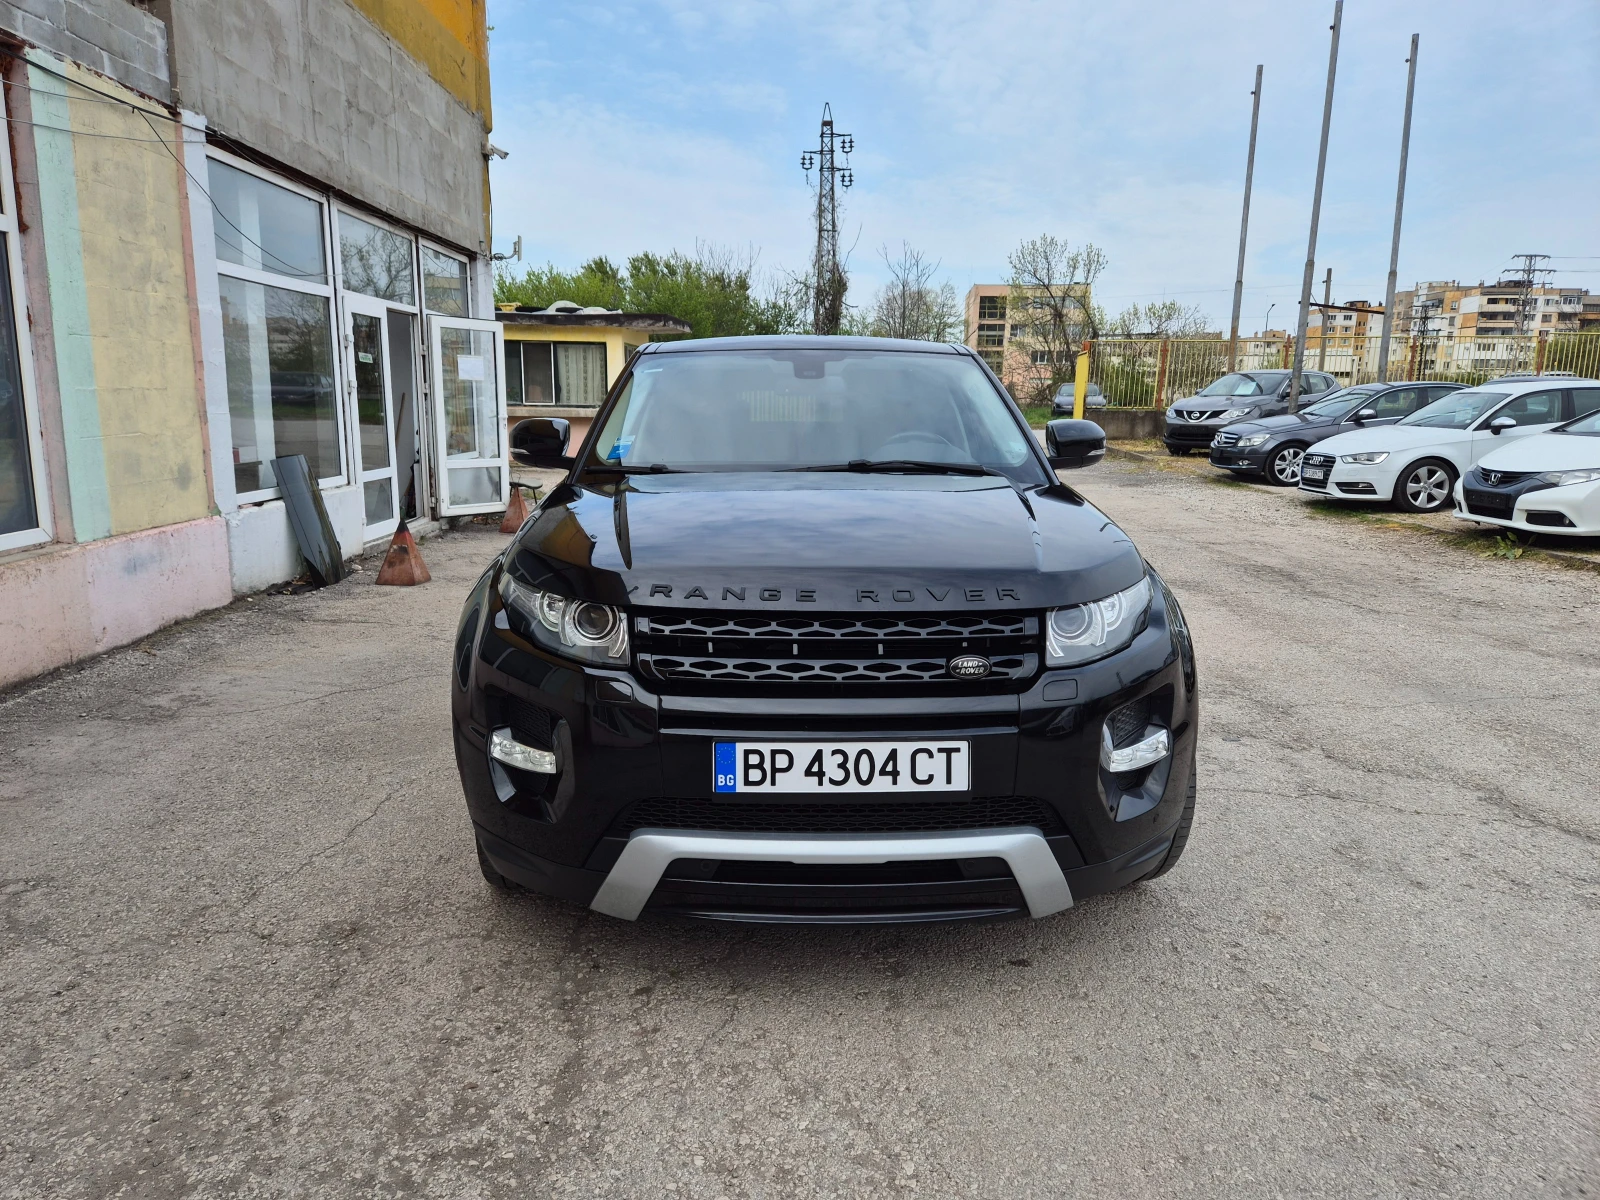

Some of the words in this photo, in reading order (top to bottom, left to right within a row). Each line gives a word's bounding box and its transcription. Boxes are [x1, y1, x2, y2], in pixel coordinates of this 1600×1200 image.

[649, 583, 817, 602] RANGE
[856, 587, 1021, 603] ROVER
[743, 748, 795, 787] BP
[804, 748, 900, 787] 4304
[910, 747, 961, 786] CT
[717, 774, 735, 786] BG
